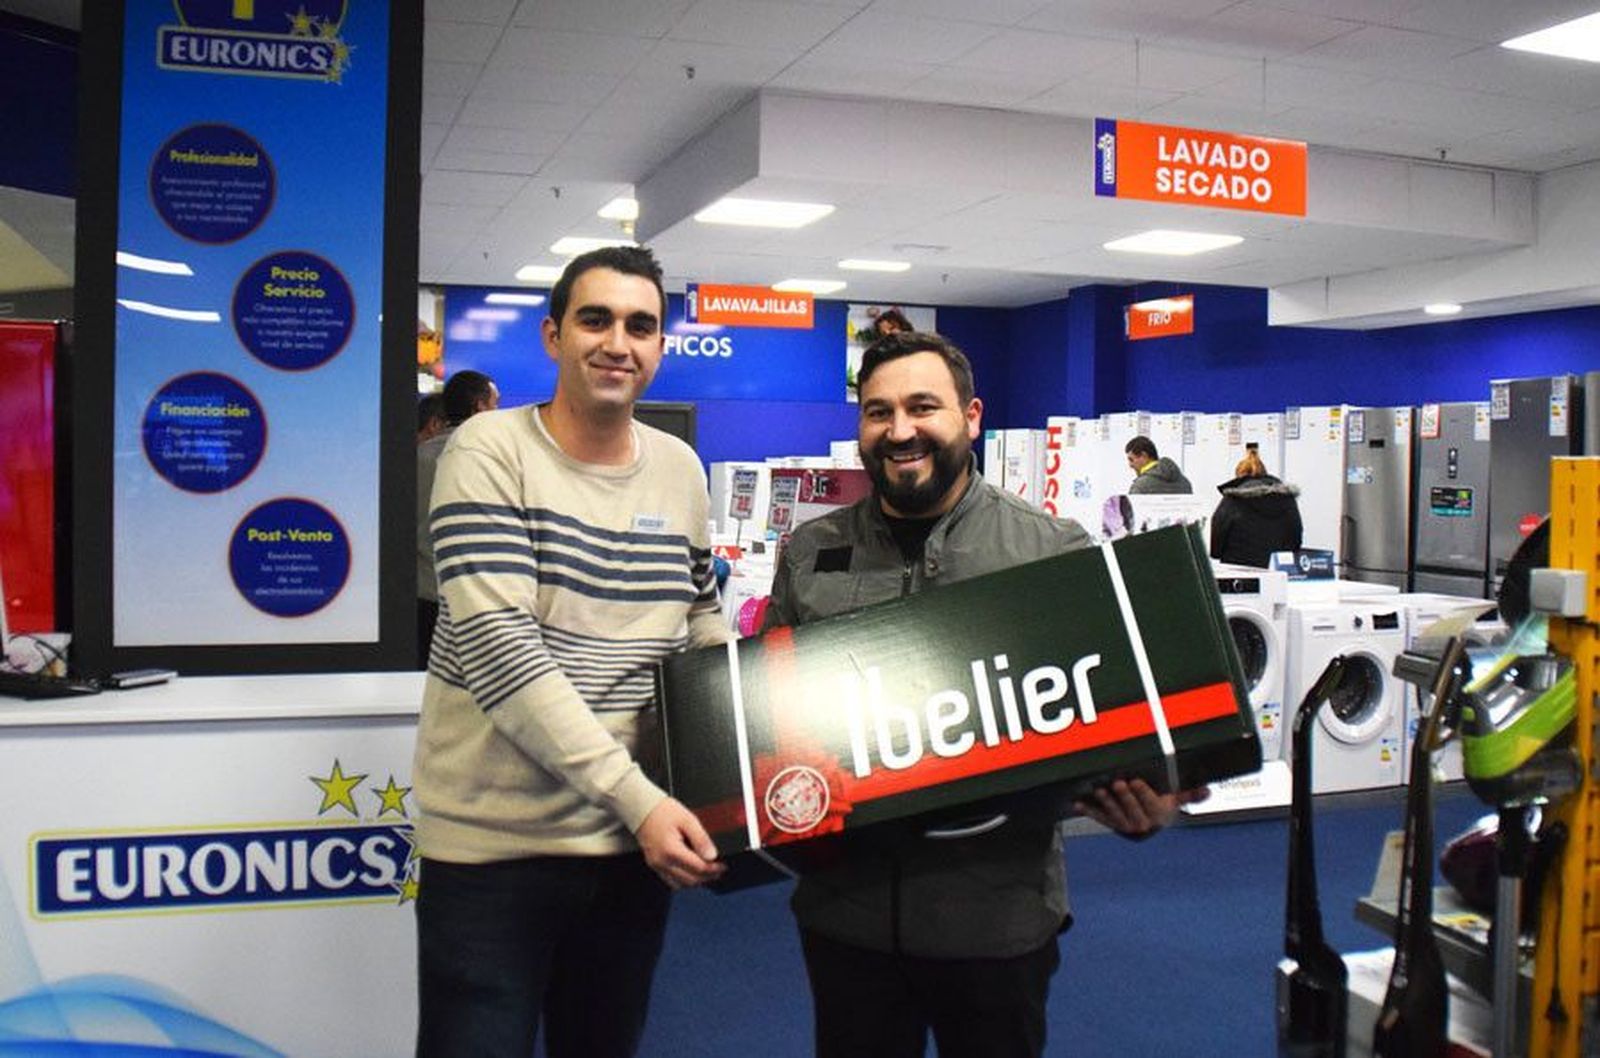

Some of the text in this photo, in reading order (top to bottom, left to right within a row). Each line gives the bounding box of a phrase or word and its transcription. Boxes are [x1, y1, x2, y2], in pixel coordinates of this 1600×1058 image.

[170, 35, 328, 71] EURONICS
[169, 148, 258, 168] Profesionalidad
[1158, 136, 1271, 173] LAVADO
[1155, 167, 1272, 203] SECADO
[271, 266, 320, 281] Precio
[263, 283, 326, 298] Servicio
[703, 297, 808, 315] LAVAVAJILLAS
[663, 335, 733, 358] FICOS
[160, 402, 250, 418] Financiación
[1043, 426, 1062, 520] OSCH
[247, 528, 333, 542] Post-Venta
[56, 835, 398, 902] EURONICS
